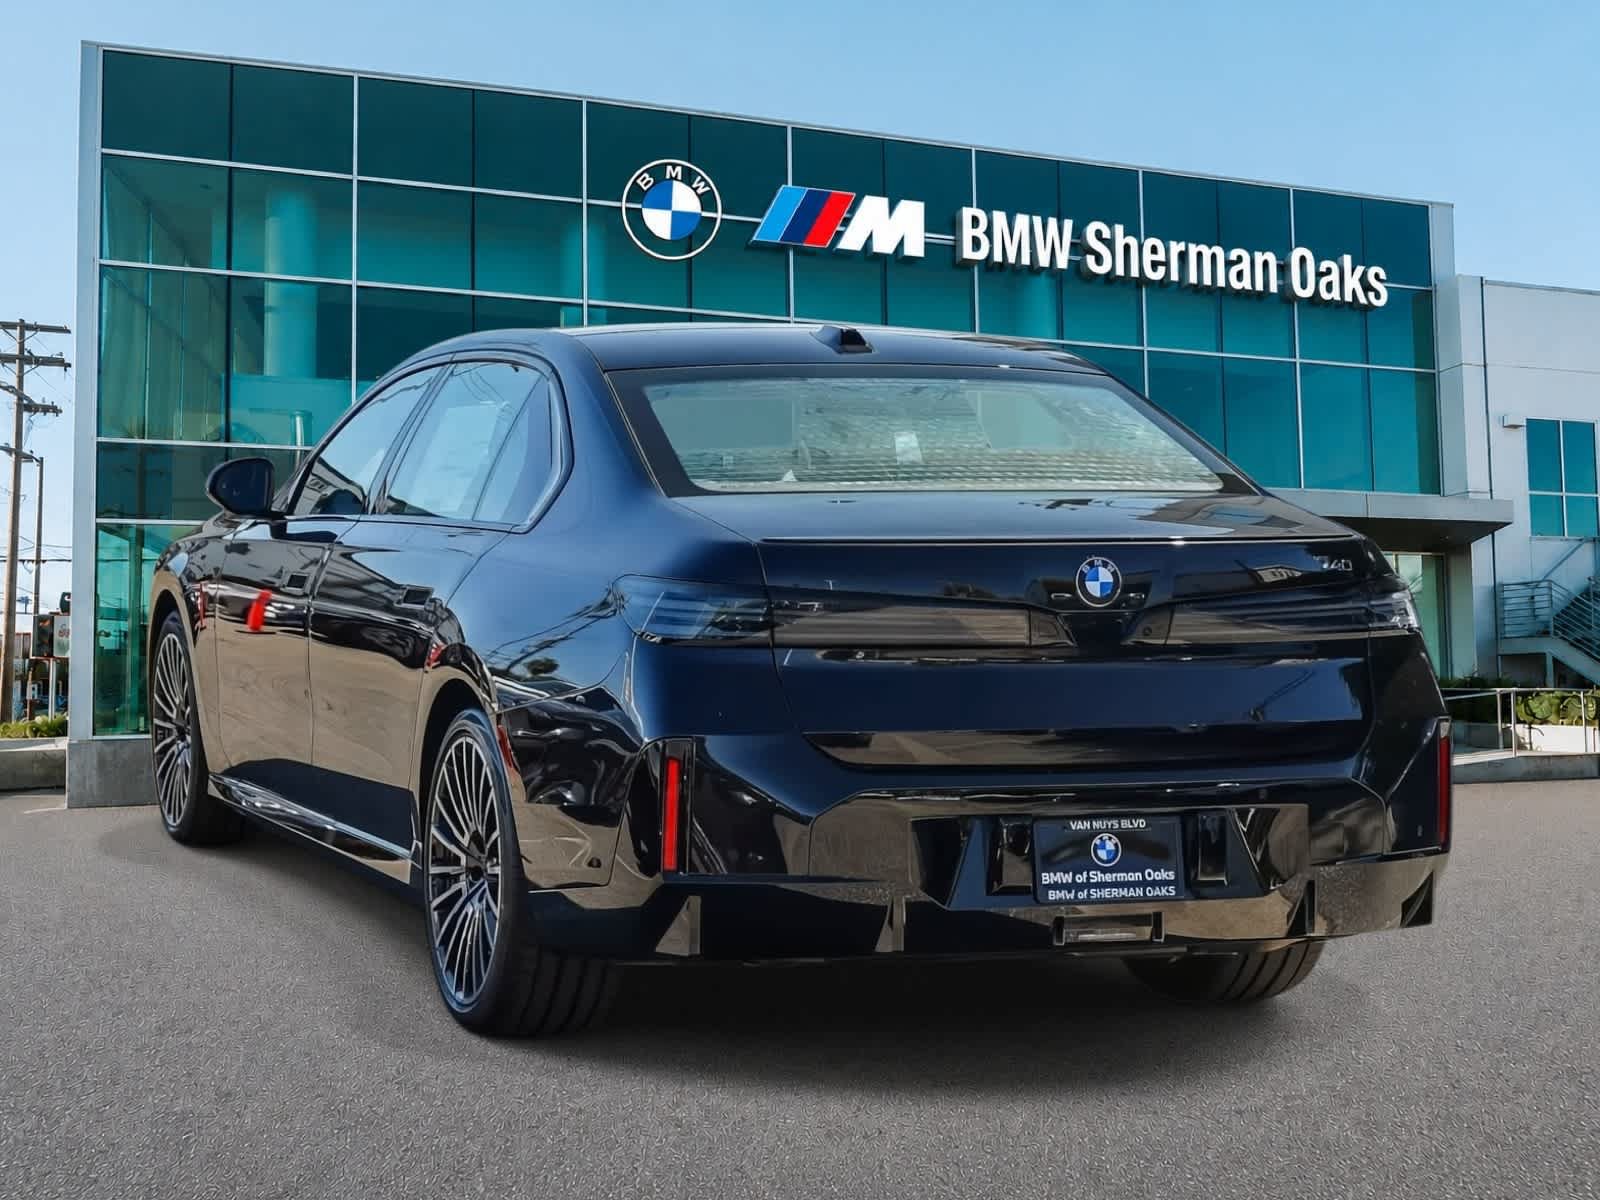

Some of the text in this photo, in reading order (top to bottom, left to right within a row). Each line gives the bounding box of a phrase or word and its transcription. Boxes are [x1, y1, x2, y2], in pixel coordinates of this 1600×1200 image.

[636, 165, 711, 195] BMW
[834, 195, 925, 257] M
[961, 207, 1389, 308] BMW Sherman Oaks
[1081, 559, 1115, 574] BMW
[1070, 818, 1146, 831] VAN NUYS BLVD
[1041, 868, 1176, 885] BMW of Sherman Oaks
[1048, 886, 1176, 900] BMW of SHERMAN OAKS
